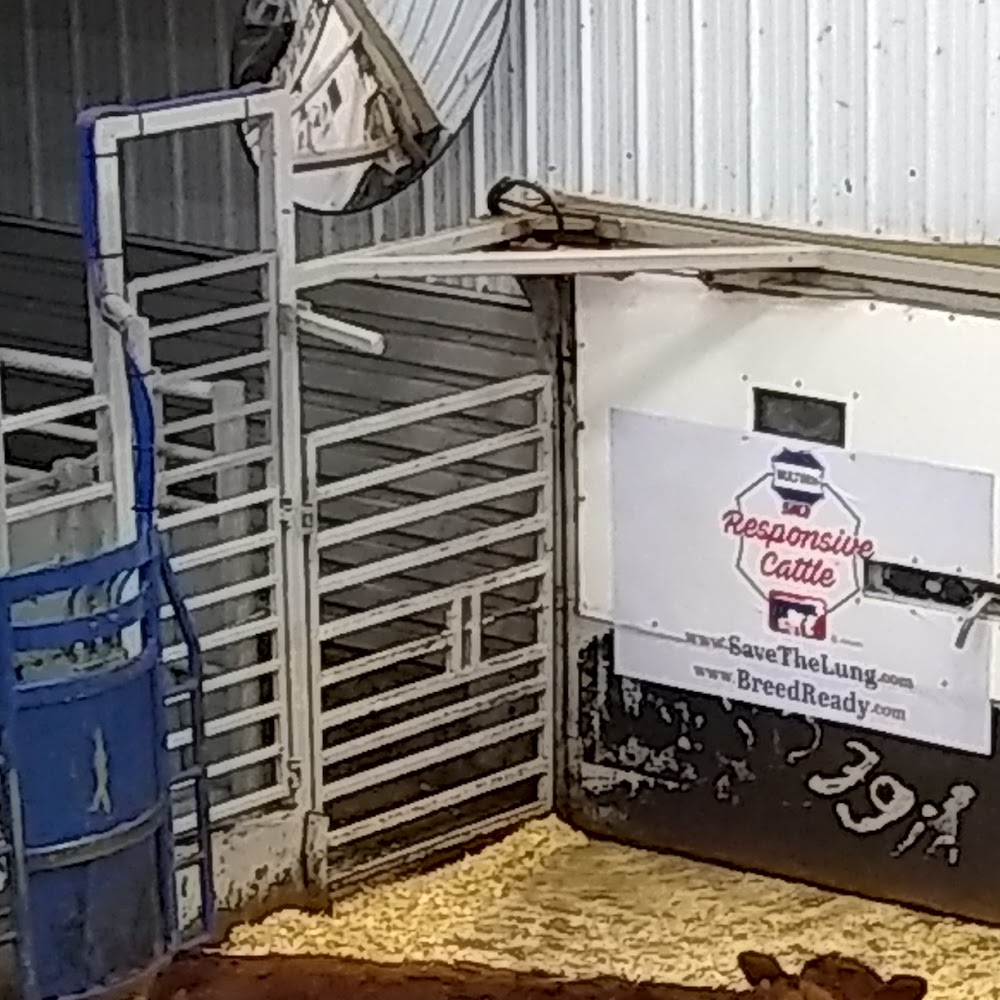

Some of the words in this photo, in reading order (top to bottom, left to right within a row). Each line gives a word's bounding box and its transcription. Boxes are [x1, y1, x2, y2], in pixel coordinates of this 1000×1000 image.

[722, 509, 874, 559] Responsive
[760, 551, 836, 588] Cattle
[685, 631, 914, 690] www.SaveTheLung.com
[693, 664, 906, 720] www.BreedReady.com
